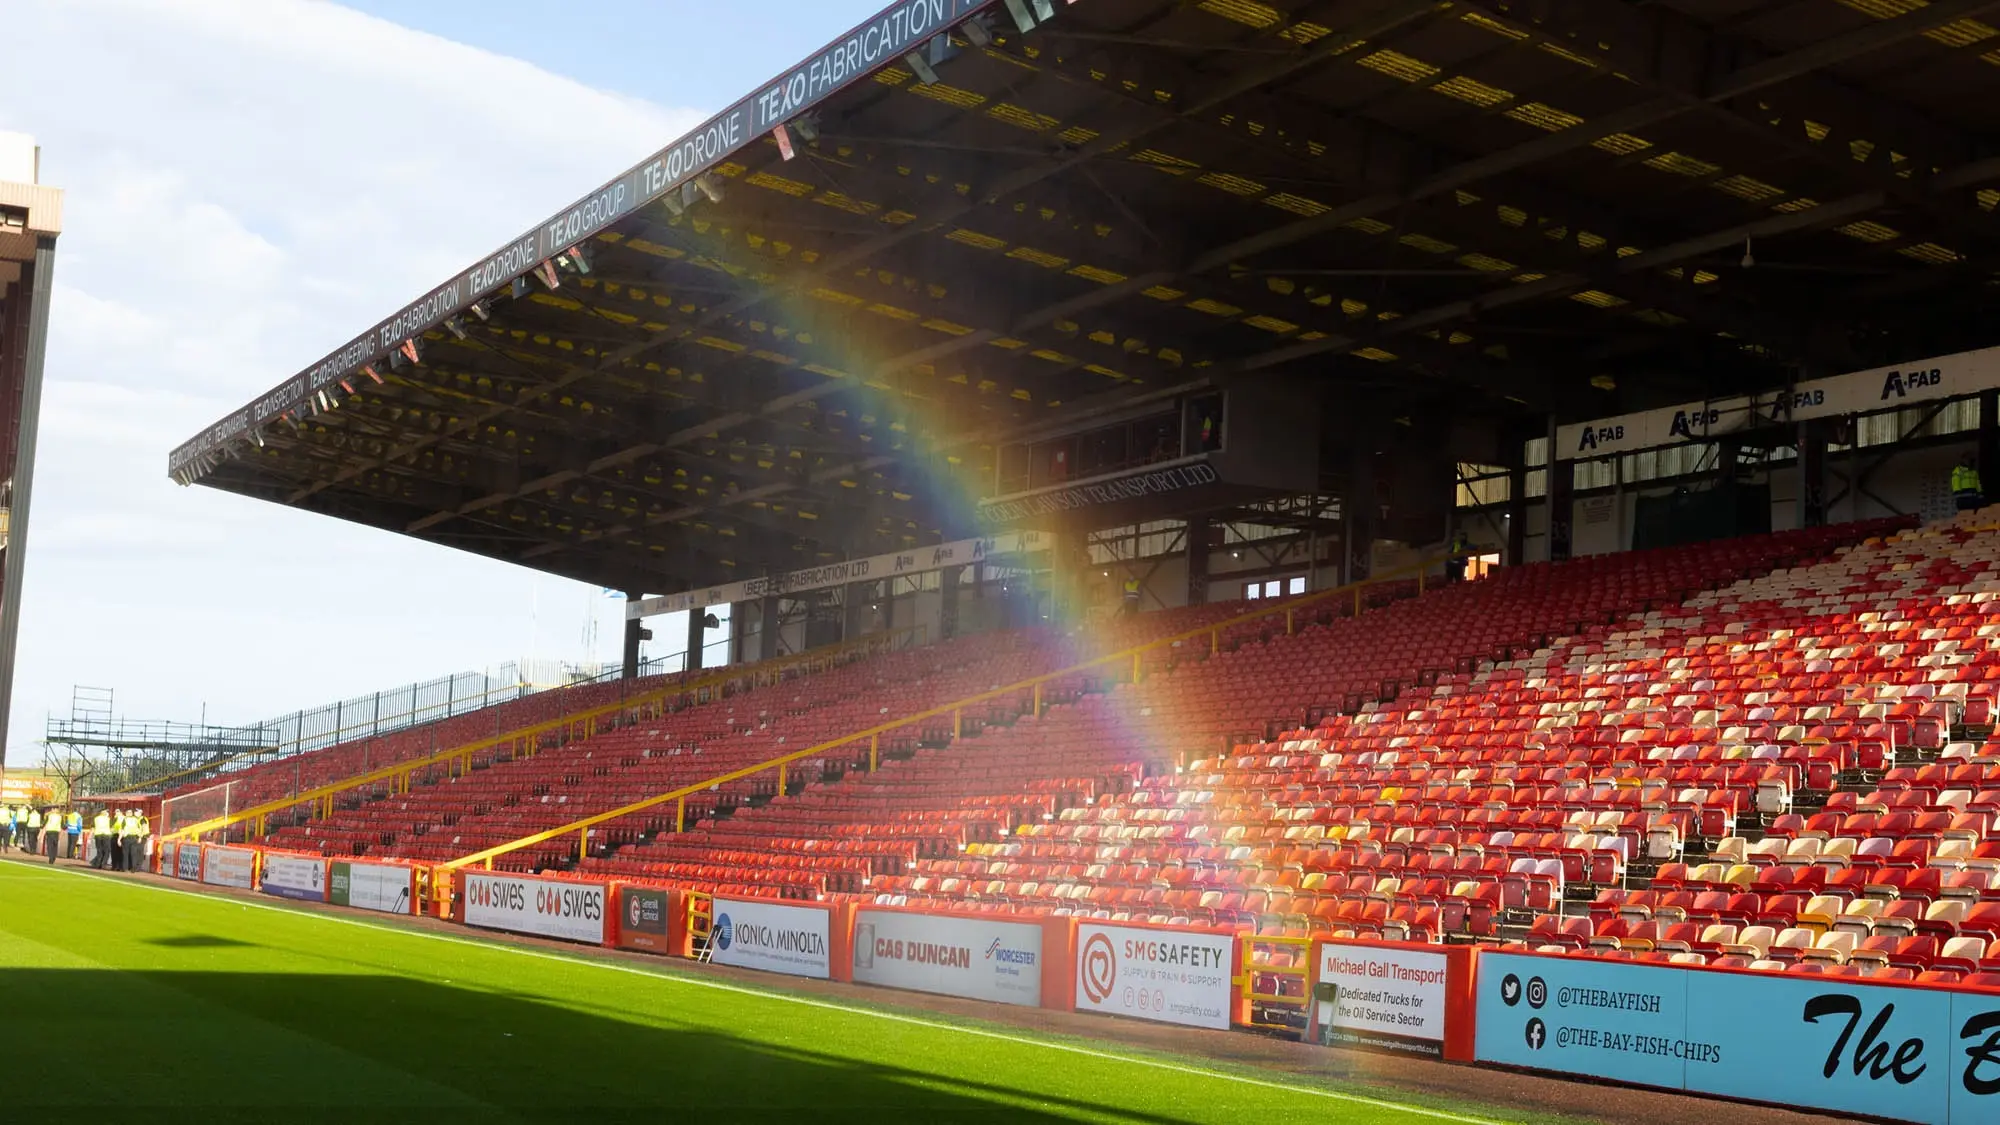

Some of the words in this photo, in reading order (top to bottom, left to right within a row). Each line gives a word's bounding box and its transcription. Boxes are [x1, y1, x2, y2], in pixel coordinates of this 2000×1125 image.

[1084, 470, 1182, 504] TRANSPORT
[1178, 463, 1216, 487] LTD
[790, 563, 849, 587] FABRICATION
[851, 560, 869, 577] LTD
[735, 923, 774, 949] KONICA
[776, 929, 825, 956] MINOLTA
[907, 941, 970, 969] DUNCAN
[995, 948, 1036, 966] WORCESTER
[1187, 974, 1222, 989] SUPPORT
[1327, 957, 1367, 976] Michael
[1368, 961, 1389, 978] Gall
[1391, 963, 1444, 986] Transport
[1340, 986, 1382, 1003] Dedicated
[1383, 991, 1410, 1006] Trucks
[1411, 994, 1424, 1008] for
[1556, 986, 1661, 1013] @THEBAYFISH
[1338, 1005, 1351, 1017] the
[1353, 1006, 1365, 1020] Oil
[1365, 1009, 1396, 1024] Service
[1397, 1014, 1425, 1028] Sector
[1555, 1026, 1721, 1064] @THE-BAY-FISH-CHIPS
[1802, 993, 1928, 1085] The
